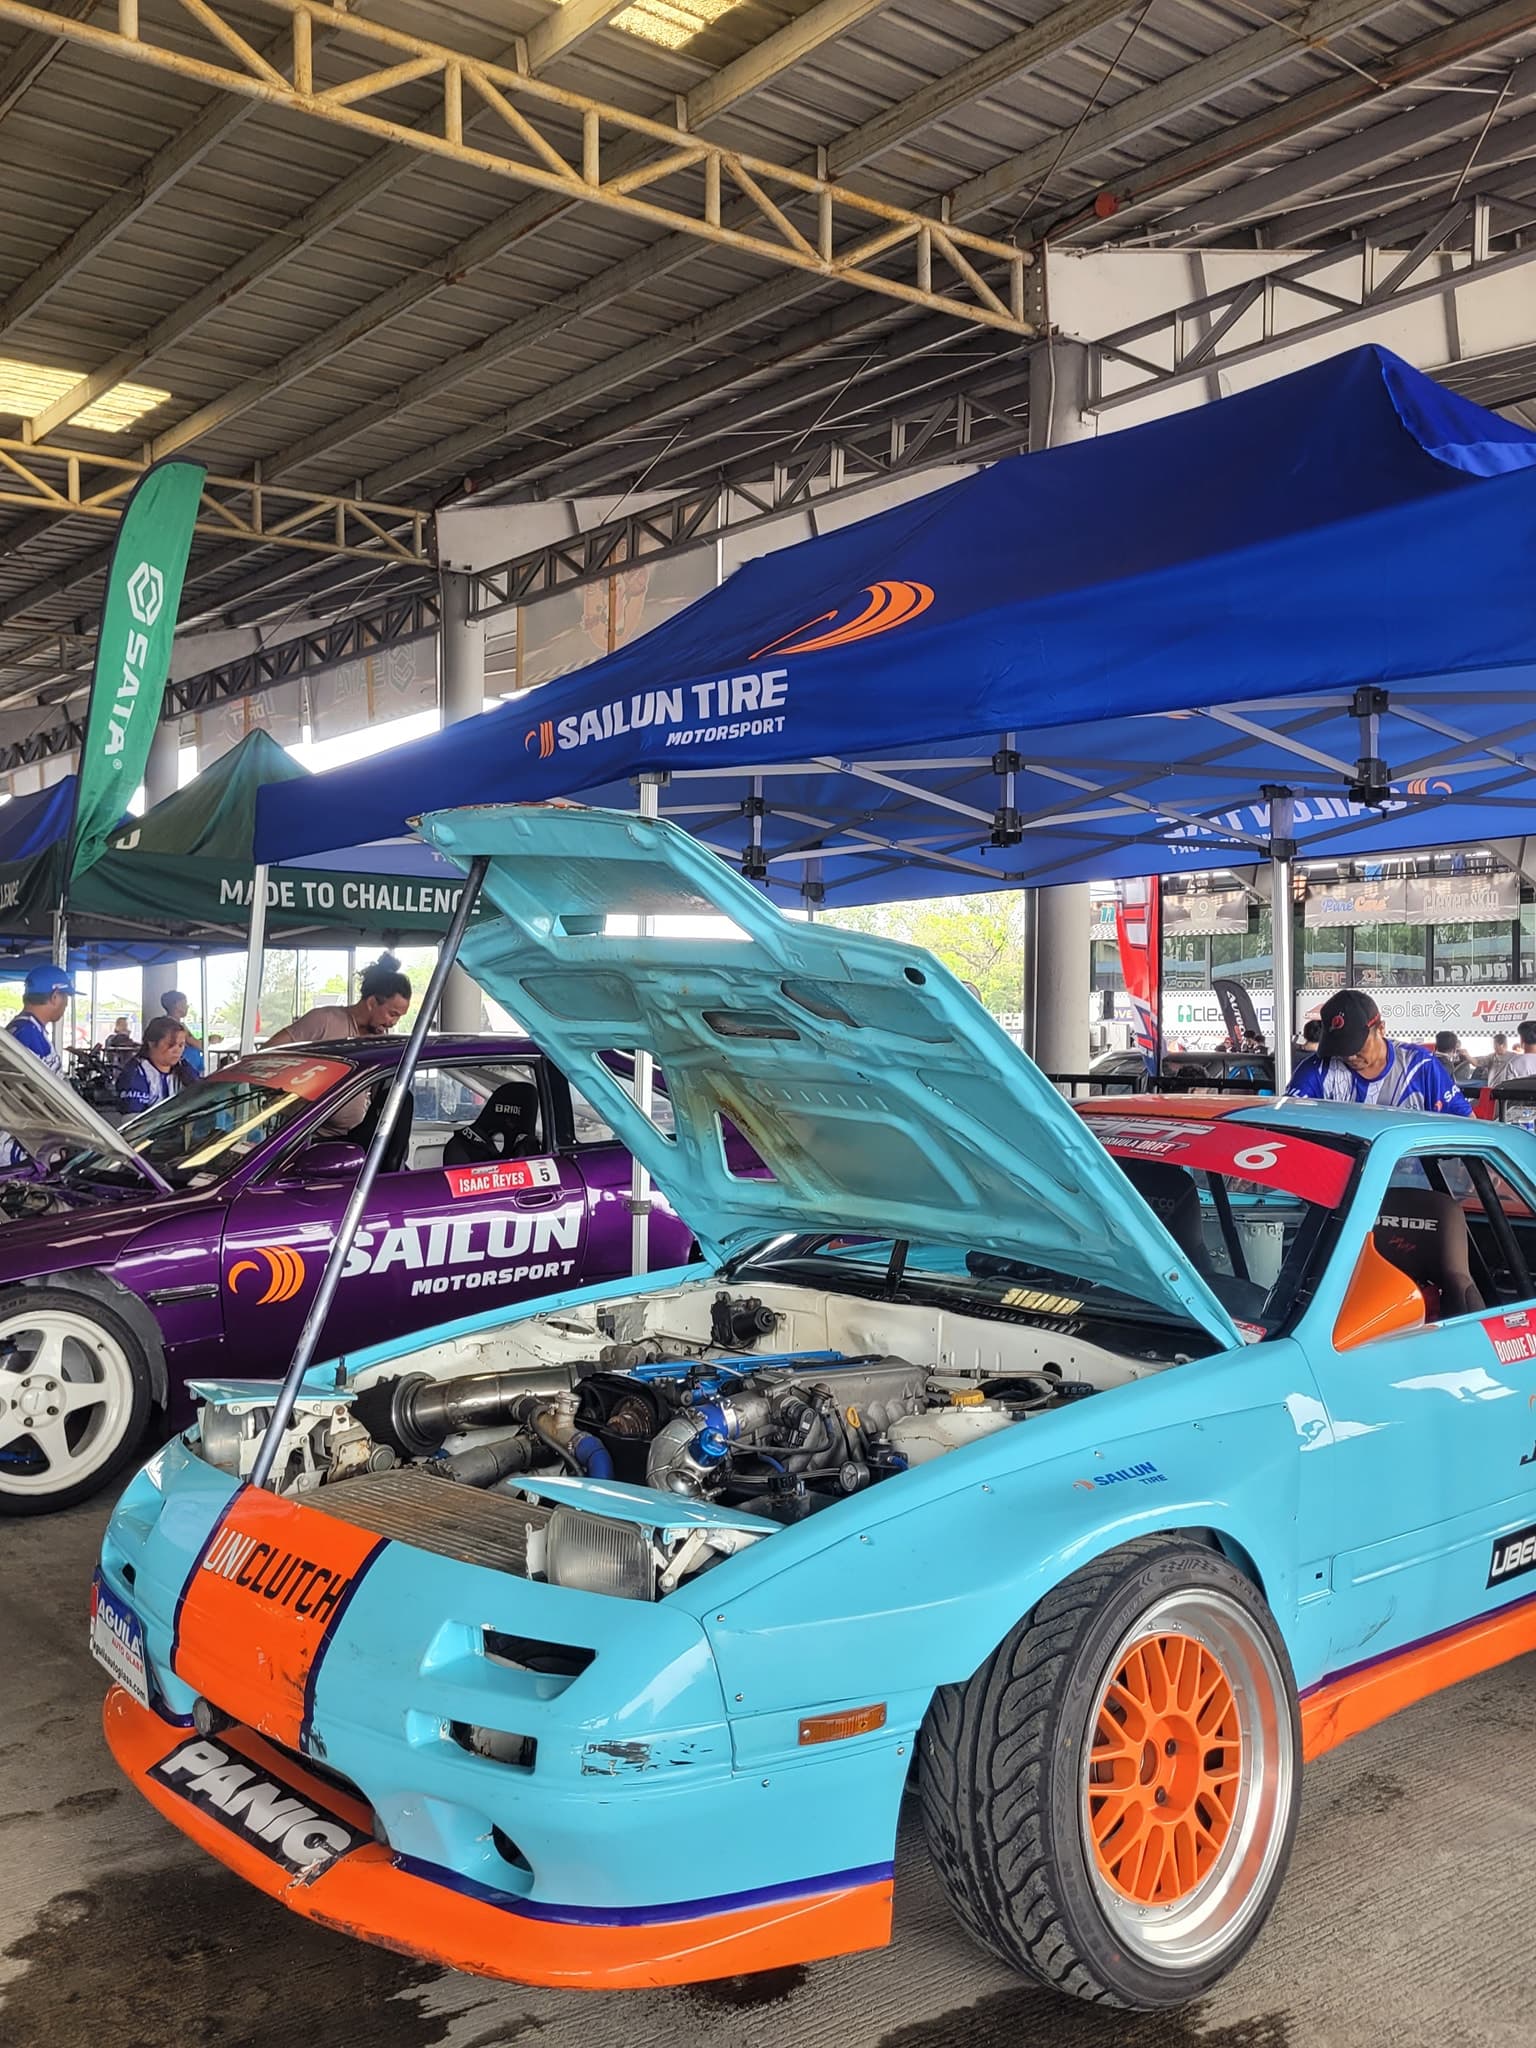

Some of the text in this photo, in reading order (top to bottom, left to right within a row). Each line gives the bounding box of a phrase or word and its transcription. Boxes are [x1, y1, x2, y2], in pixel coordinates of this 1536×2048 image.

[105, 628, 149, 756] SATA
[557, 668, 789, 750] SAILUN TIRE
[665, 716, 786, 747] MOTORSPORT
[302, 882, 335, 908] TO
[1233, 1142, 1288, 1170] 6
[459, 1171, 525, 1193] ISAAC REYES
[540, 1168, 551, 1182] 5
[328, 1205, 583, 1278] SAILUN
[411, 1260, 576, 1297] MOTORSPORT
[1093, 1461, 1159, 1486] SAILUN
[1138, 1473, 1169, 1486] TIRE
[202, 1527, 353, 1625] UNICLUTCH
[97, 1597, 141, 1657] AGUILA
[159, 1739, 352, 1866] PANIC
